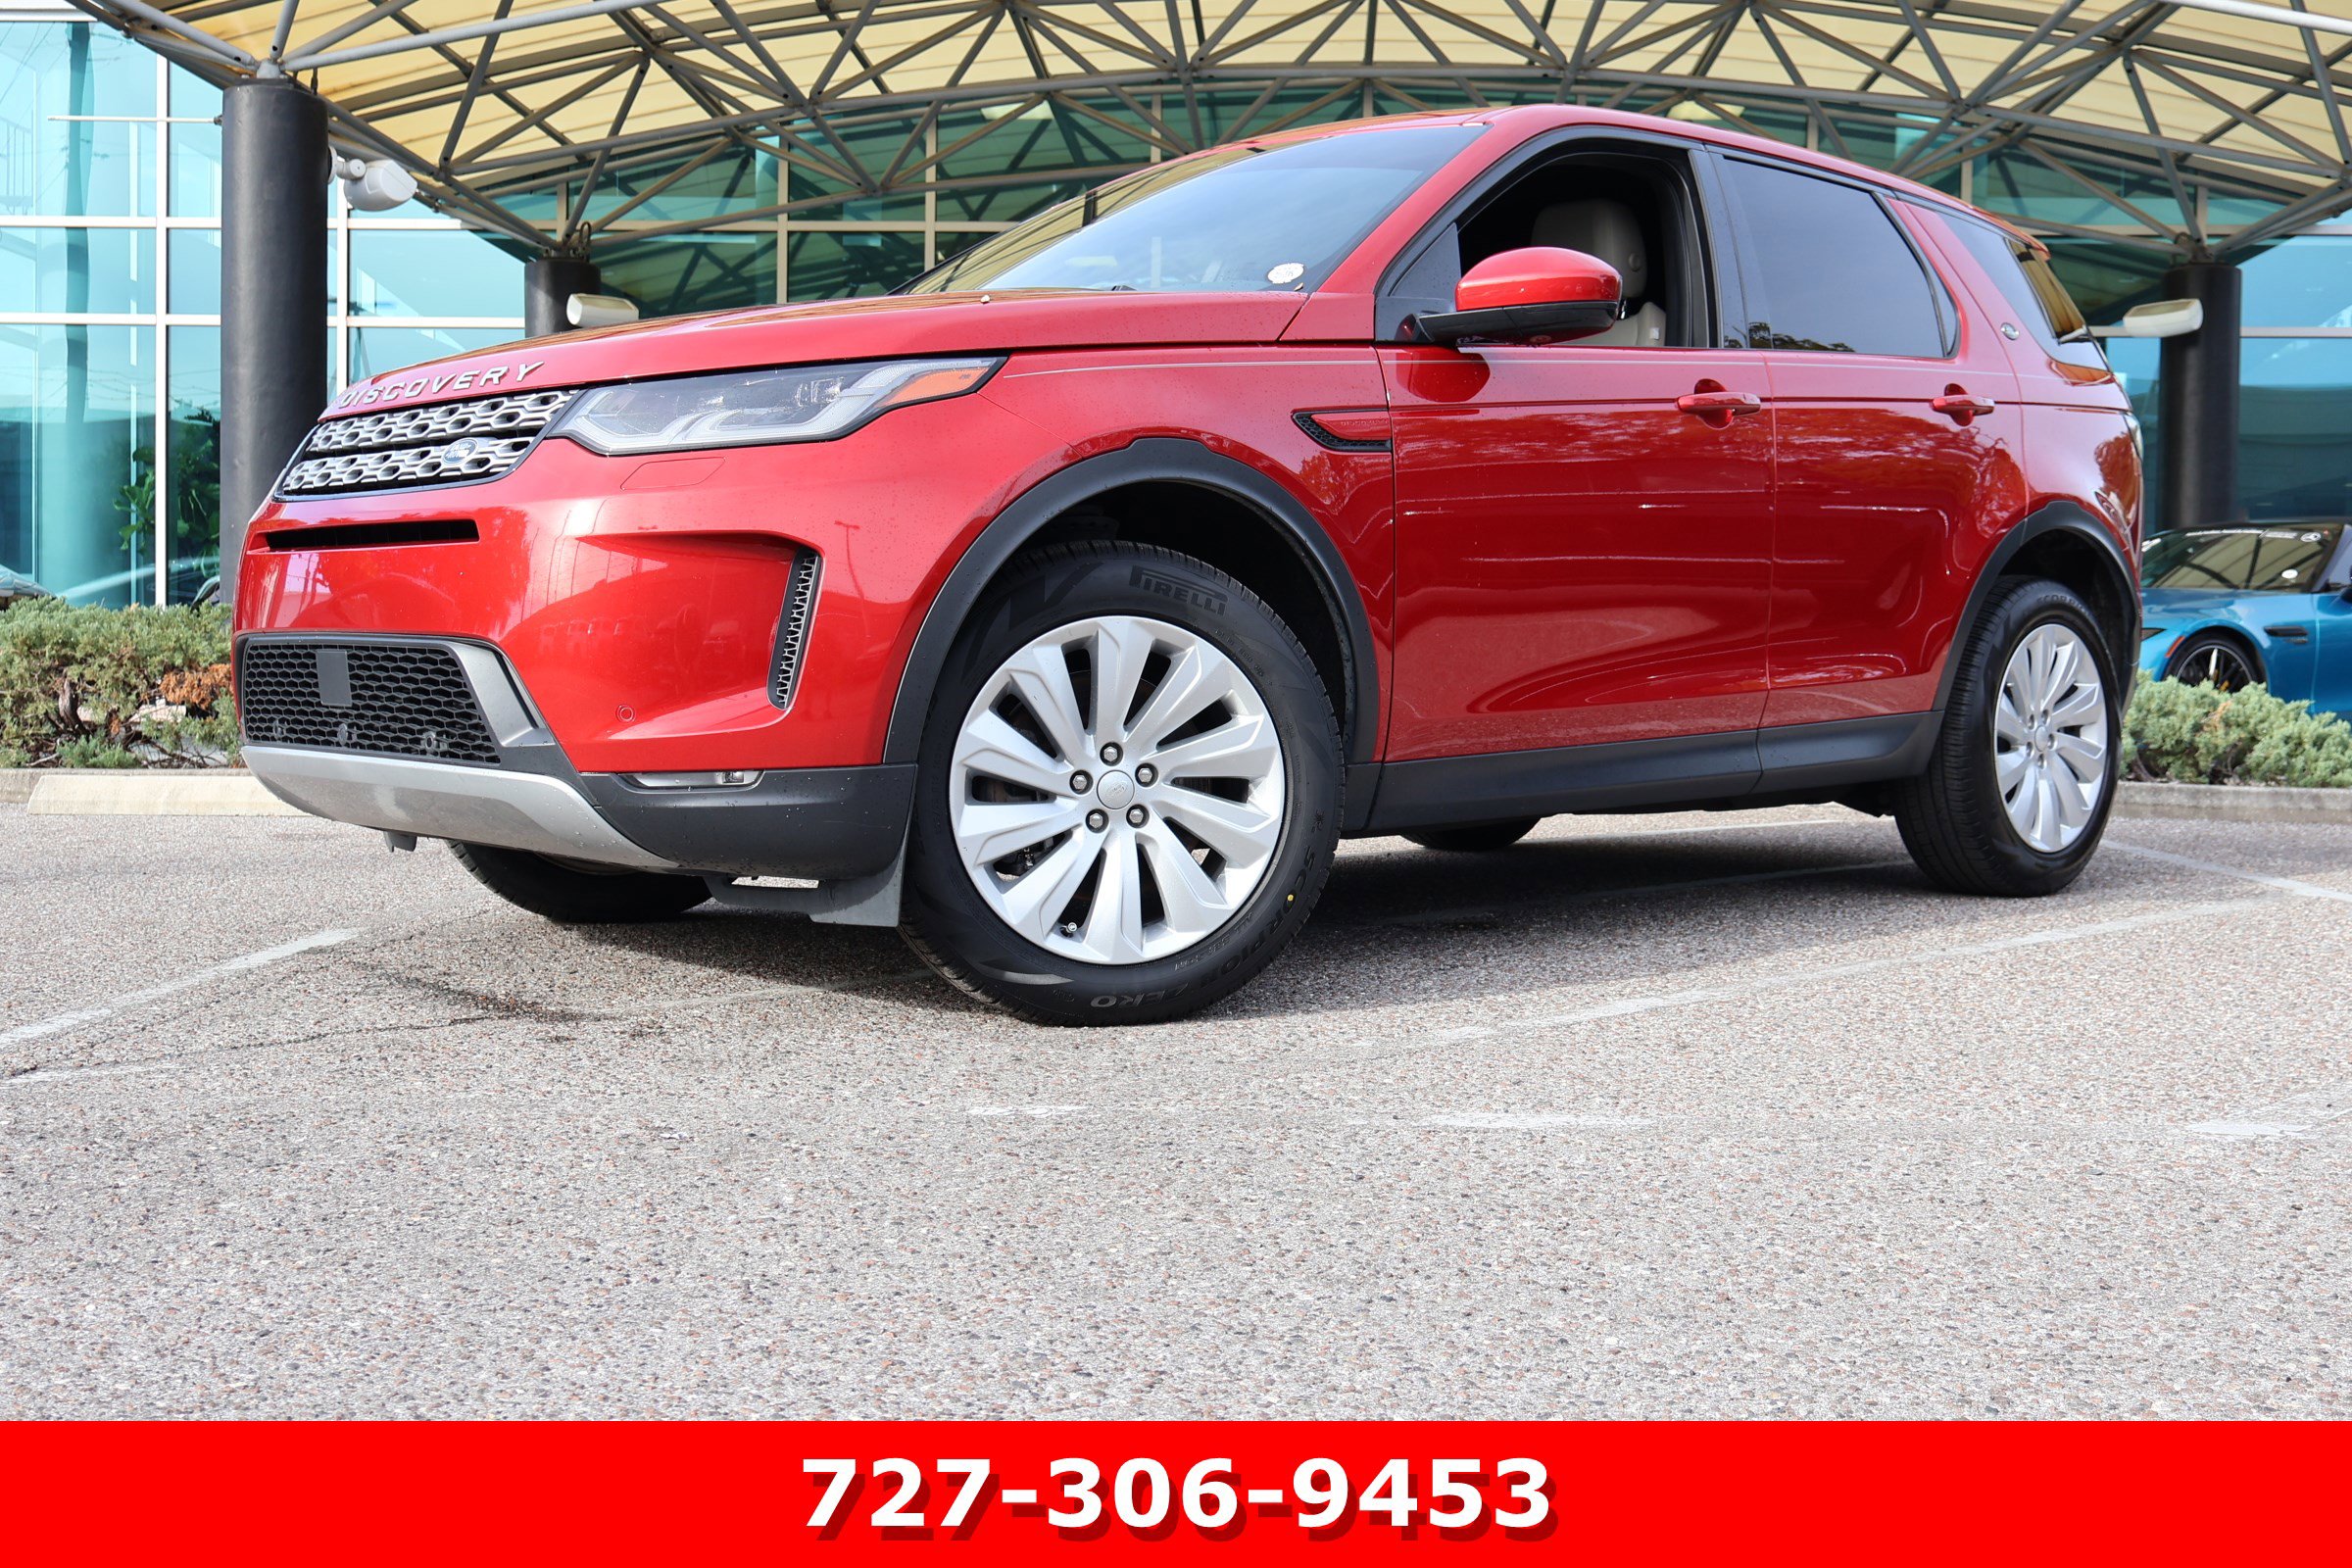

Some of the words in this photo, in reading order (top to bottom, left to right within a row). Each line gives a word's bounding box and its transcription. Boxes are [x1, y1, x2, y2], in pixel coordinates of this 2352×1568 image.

[338, 361, 545, 409] DISCOVERY
[1129, 564, 1229, 616] PIRELLI
[1090, 981, 1190, 1008] ZERO
